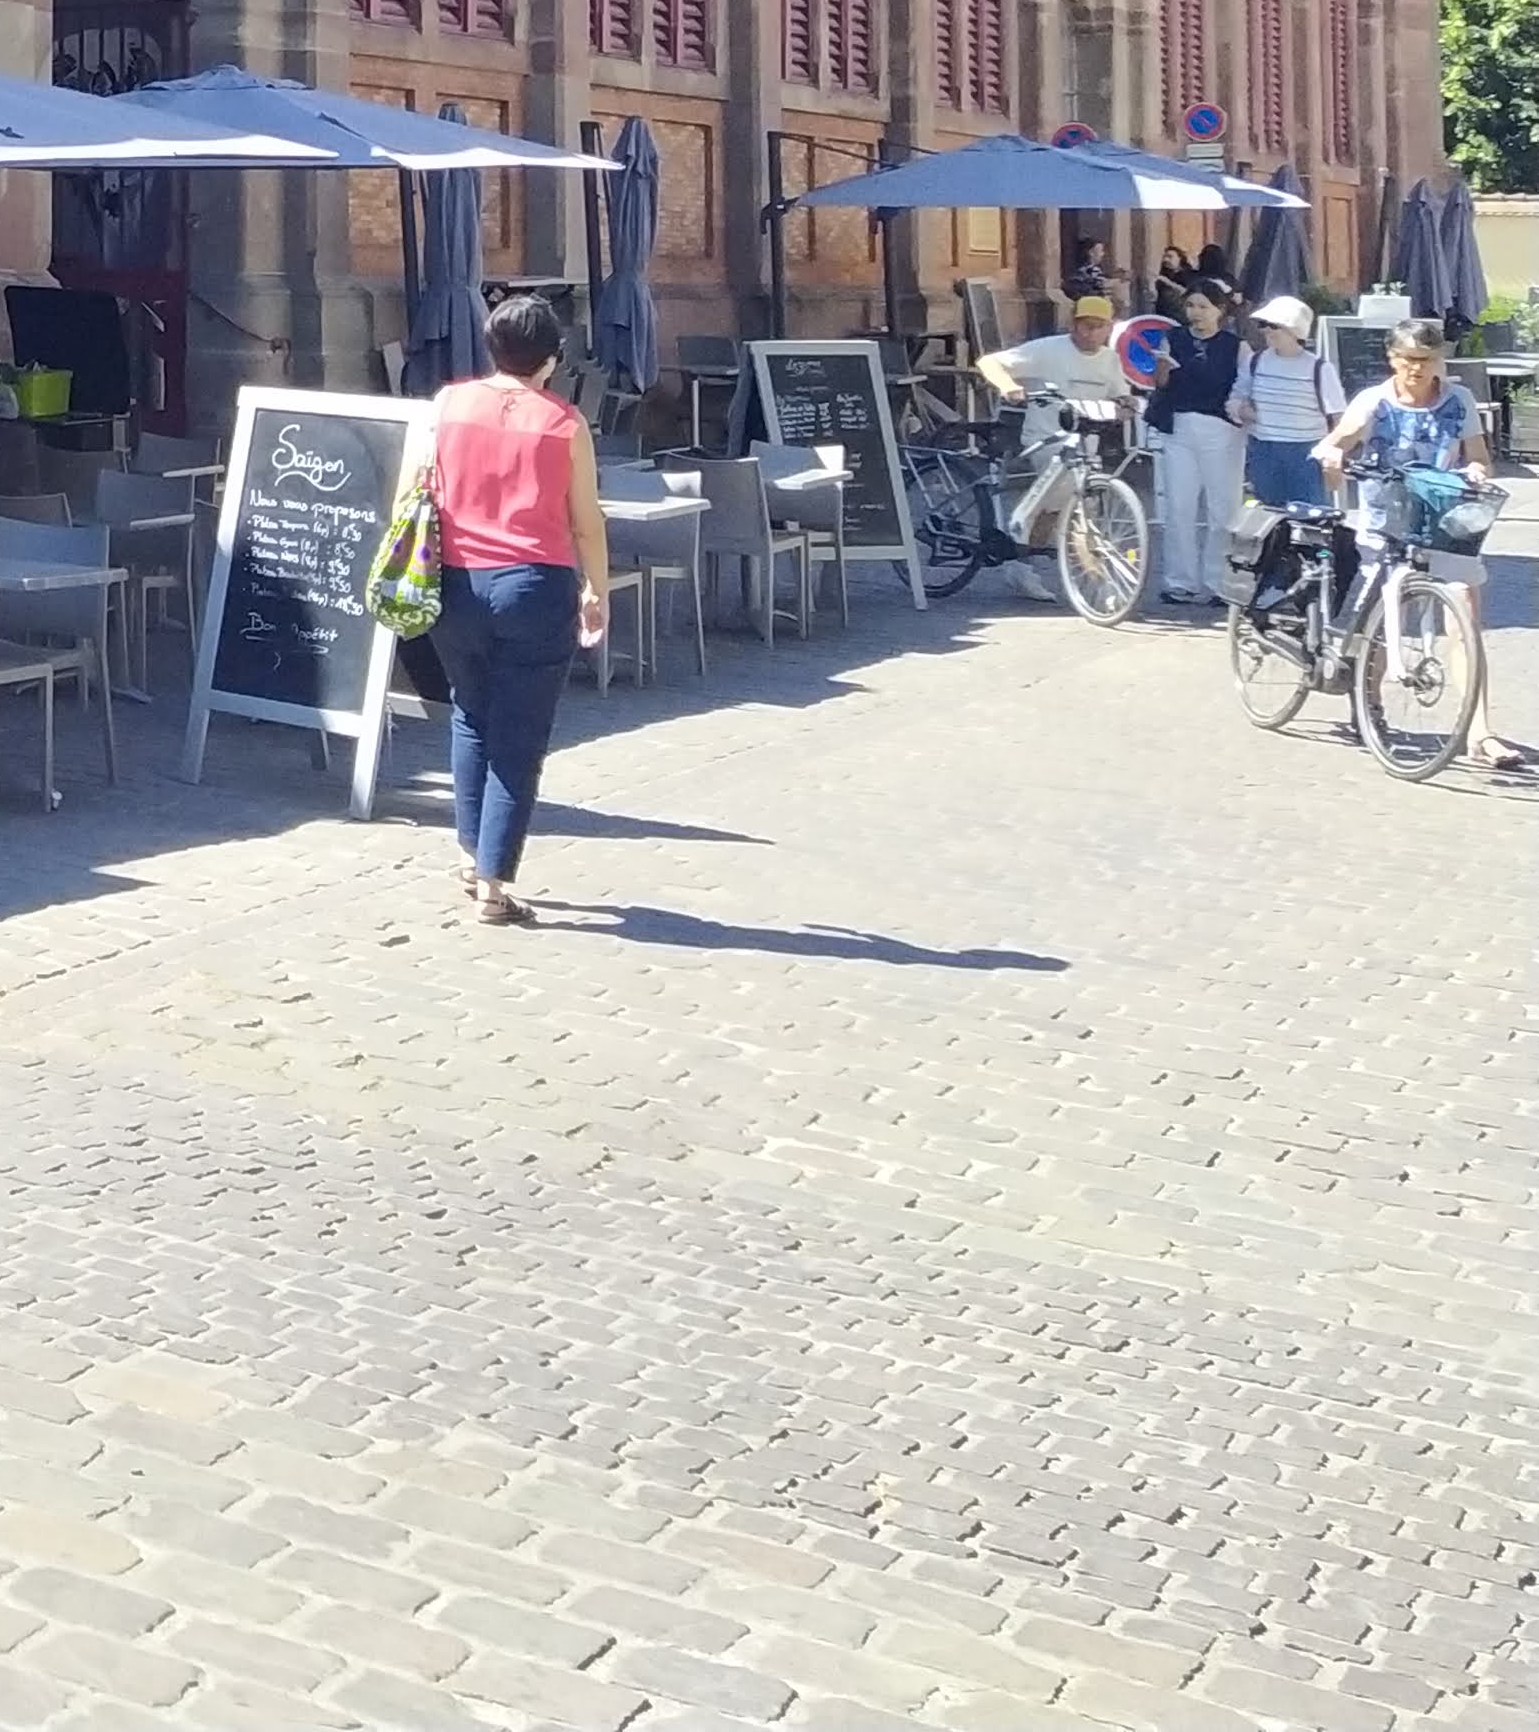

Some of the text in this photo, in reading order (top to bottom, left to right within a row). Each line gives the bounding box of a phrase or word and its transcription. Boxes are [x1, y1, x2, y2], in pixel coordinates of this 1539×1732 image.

[249, 489, 278, 507] Nous
[310, 502, 376, 527] proposons
[241, 612, 277, 634] Bon
